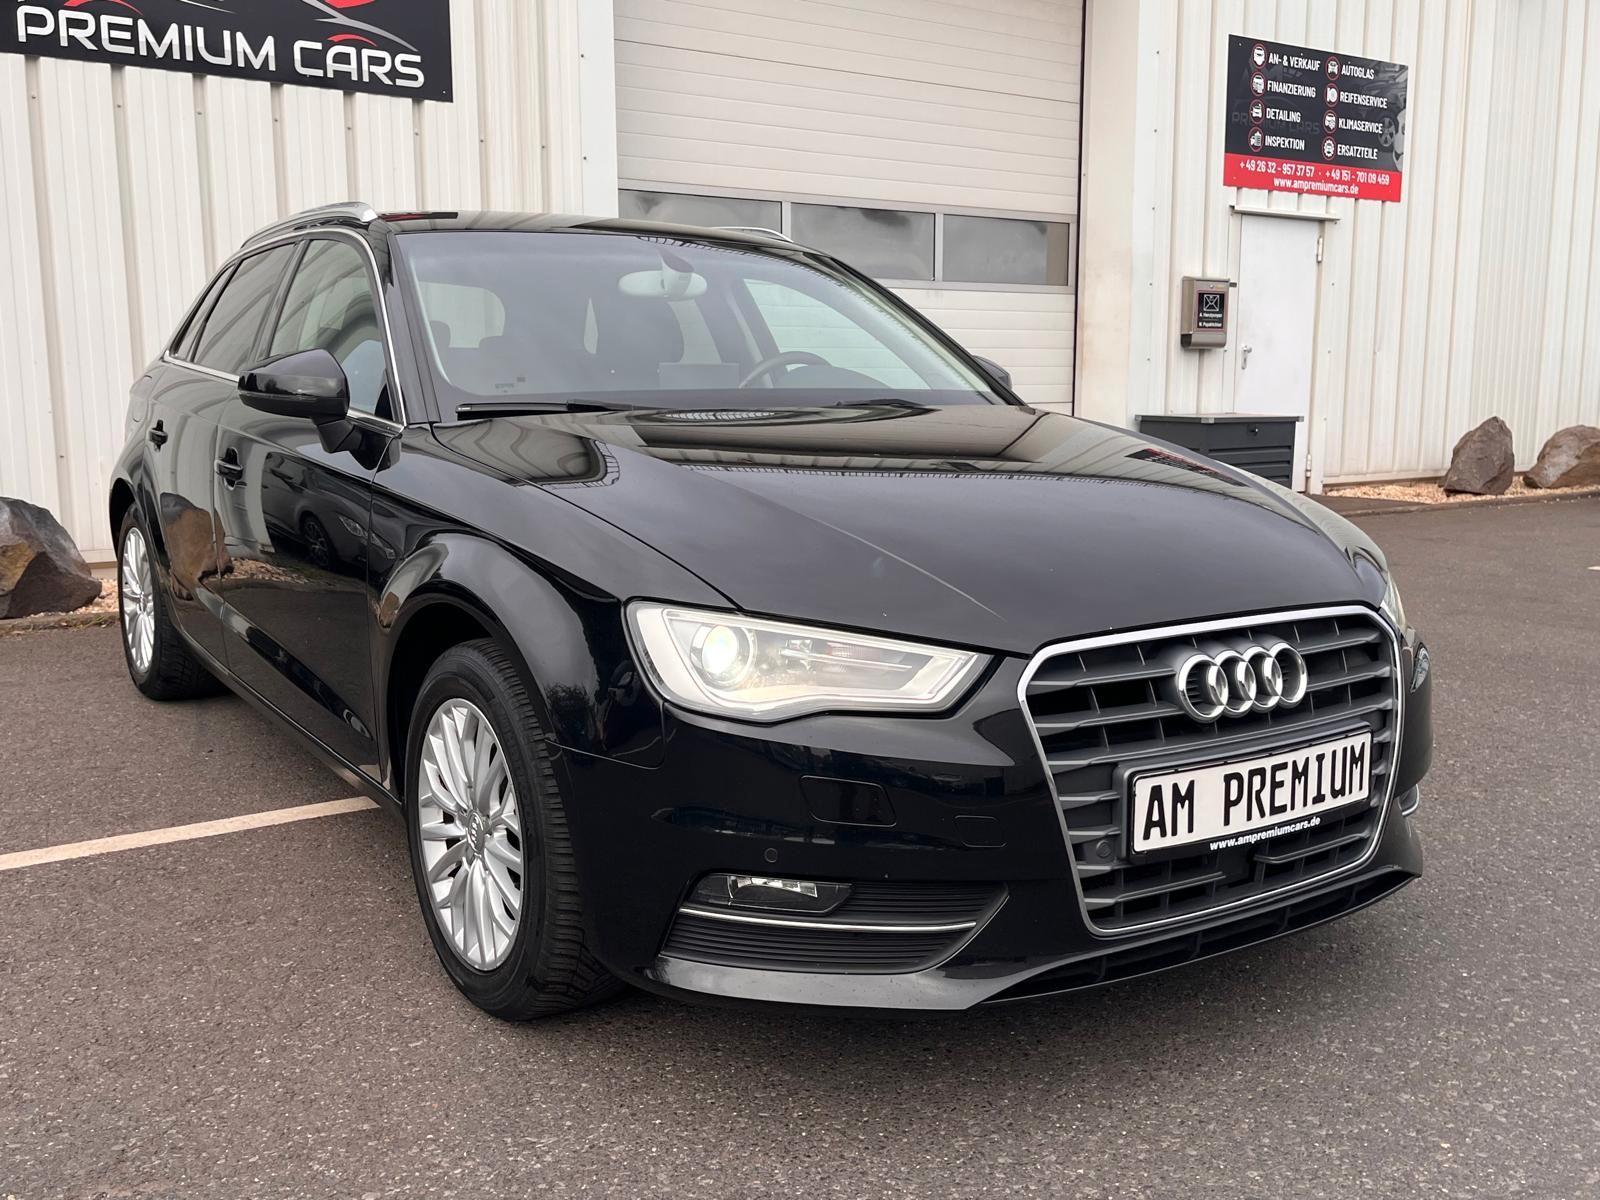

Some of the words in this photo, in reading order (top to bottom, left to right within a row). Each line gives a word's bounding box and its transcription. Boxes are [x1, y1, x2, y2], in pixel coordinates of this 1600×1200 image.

[16, 5, 276, 71] PREMIUM
[293, 39, 425, 88] CARS
[1268, 53, 1281, 63] AN-
[1283, 54, 1288, 63] &
[1289, 55, 1321, 71] VERKAUF
[1341, 64, 1375, 80] AUTOGLAS
[1267, 81, 1316, 98] FINANZIERUNG
[1340, 91, 1387, 108] REIFENSERVICE
[1266, 108, 1302, 123] DETAILING
[1338, 118, 1383, 134] KLIMASERVICE
[1264, 135, 1305, 151] INSPEKTION
[1337, 143, 1378, 160] ERSATZTEILE
[1274, 178, 1359, 194] www.ampremiumcars.de
[1142, 779, 1195, 841] AM
[1223, 741, 1366, 827] PREMIUM
[1209, 816, 1321, 851] www.ampremiumcars.de
